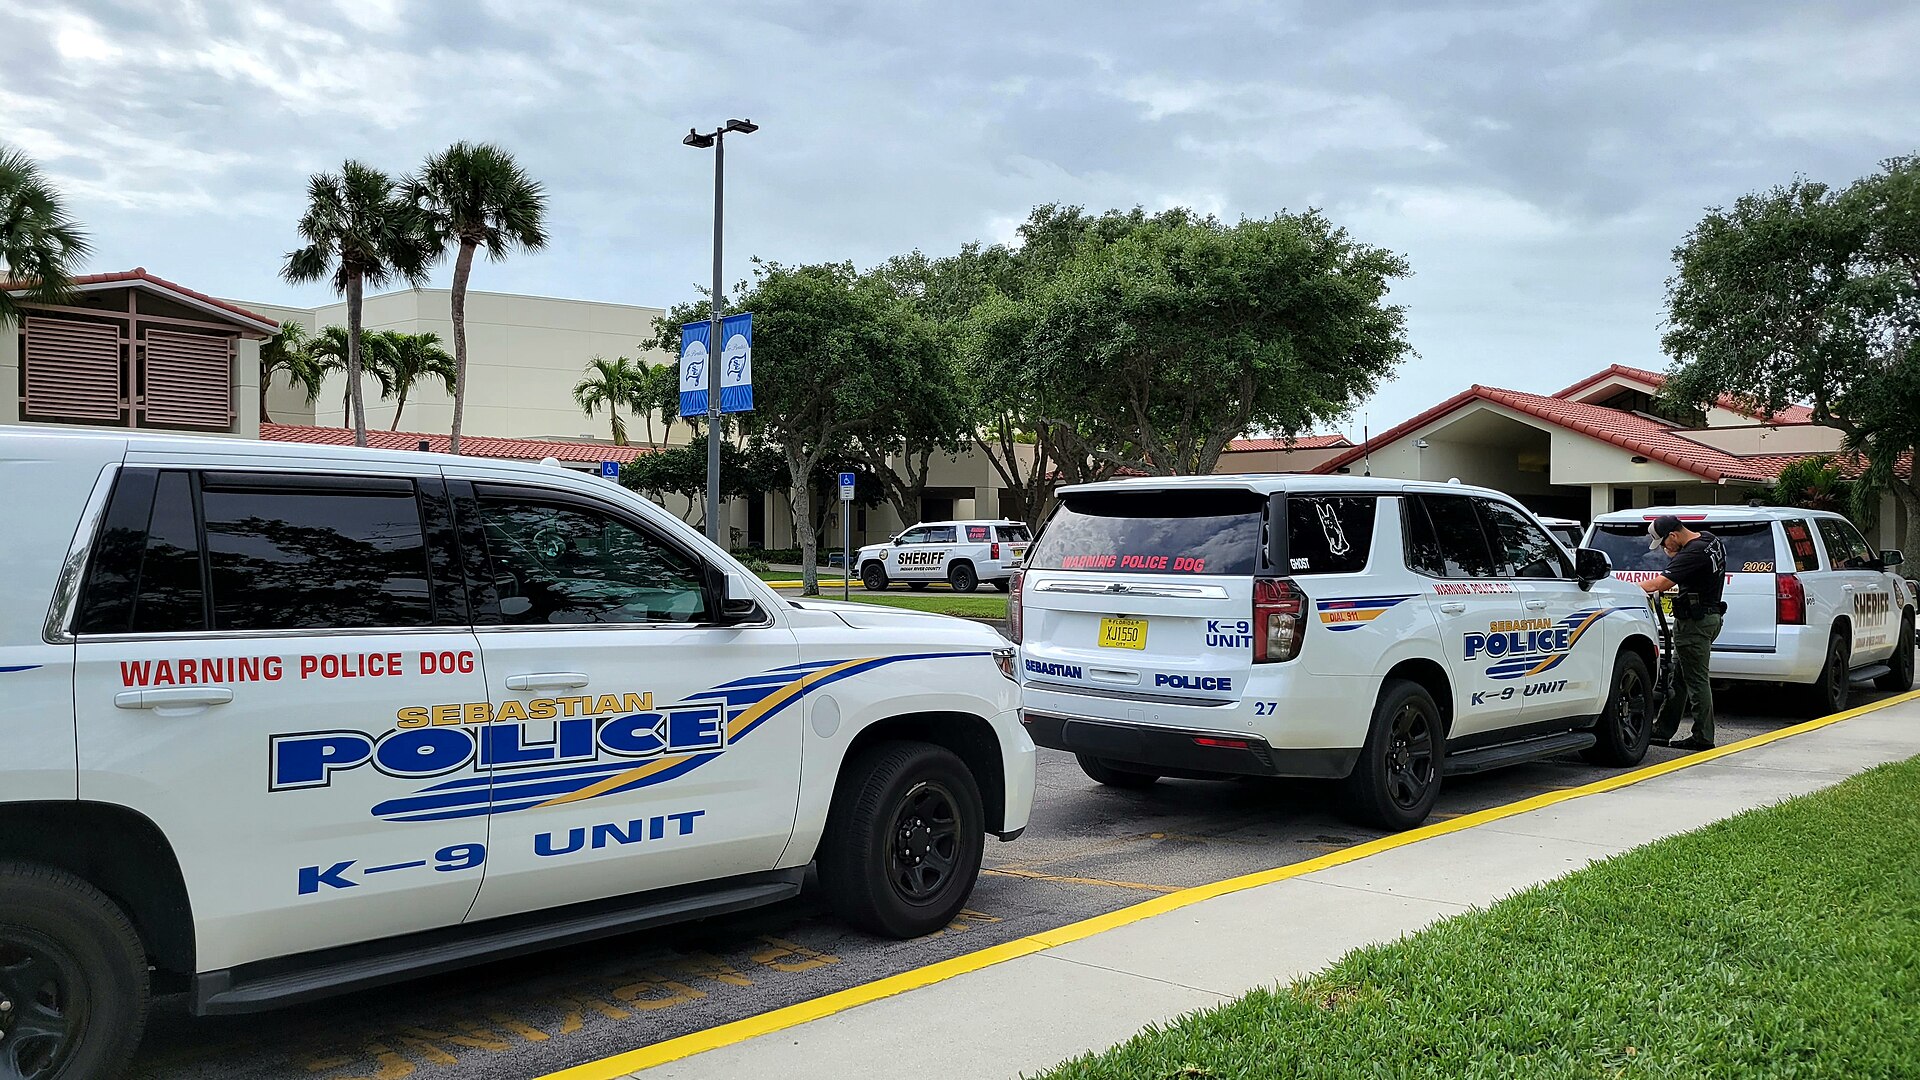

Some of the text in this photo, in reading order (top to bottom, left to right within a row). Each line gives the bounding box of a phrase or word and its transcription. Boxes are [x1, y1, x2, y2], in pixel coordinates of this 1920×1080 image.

[898, 552, 945, 565] SHERIFF
[1061, 555, 1205, 573] WARNING POLICE DOG
[1290, 558, 1310, 570] GHOST
[1742, 561, 1773, 572] 2004
[1432, 583, 1513, 595] WARNING POLICE DOG
[1329, 611, 1359, 622] DIAL 911
[1854, 592, 1889, 628] SHERIFF
[1207, 620, 1249, 634] K-9
[1490, 618, 1551, 633] SEBASTIAN
[1105, 626, 1138, 642] XJ1550
[1206, 634, 1253, 648] UNIT
[1463, 623, 1571, 661] POLICE
[120, 650, 474, 687] WARNING POLICE DOG
[1025, 659, 1232, 691] SEBASTIAN POLICE
[1471, 680, 1568, 706] K-9 UNIT
[396, 691, 653, 730] SEBASTIAN
[1254, 701, 1278, 716] 27
[268, 697, 728, 792] POLICE
[298, 809, 706, 895] K-9 UNIT
